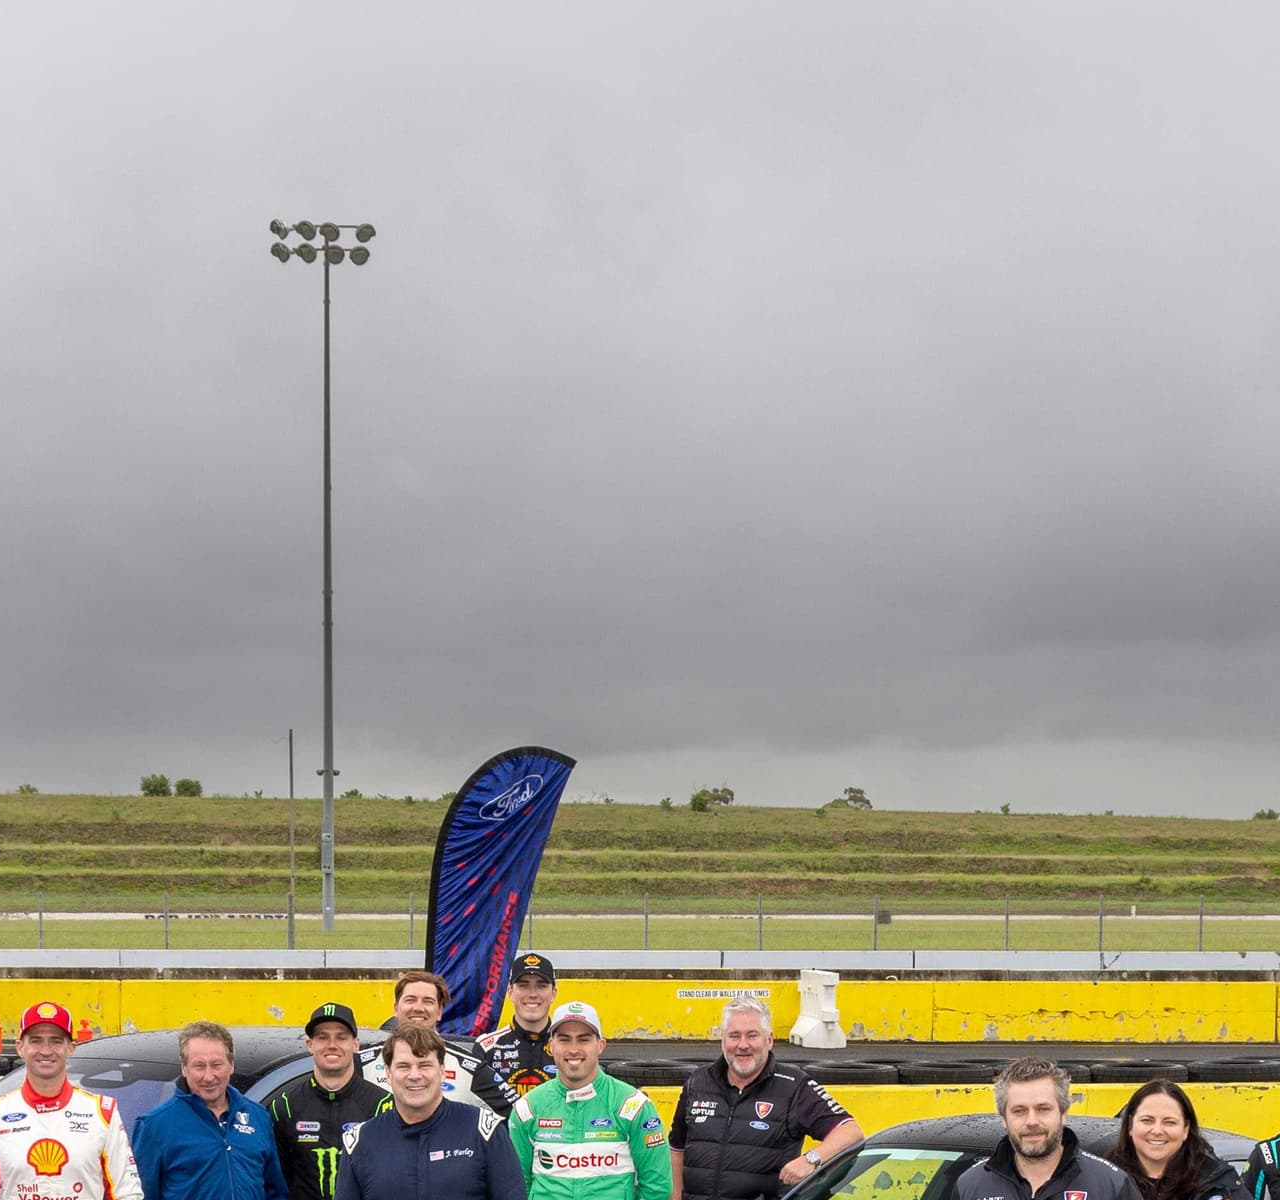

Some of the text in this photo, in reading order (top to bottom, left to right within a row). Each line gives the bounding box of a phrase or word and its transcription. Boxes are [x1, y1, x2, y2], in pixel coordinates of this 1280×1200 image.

[472, 890, 519, 1037] PERFORMANCE
[691, 1108, 715, 1116] OPTUS
[556, 1152, 619, 1168] Castrol
[17, 1184, 38, 1193] Shell
